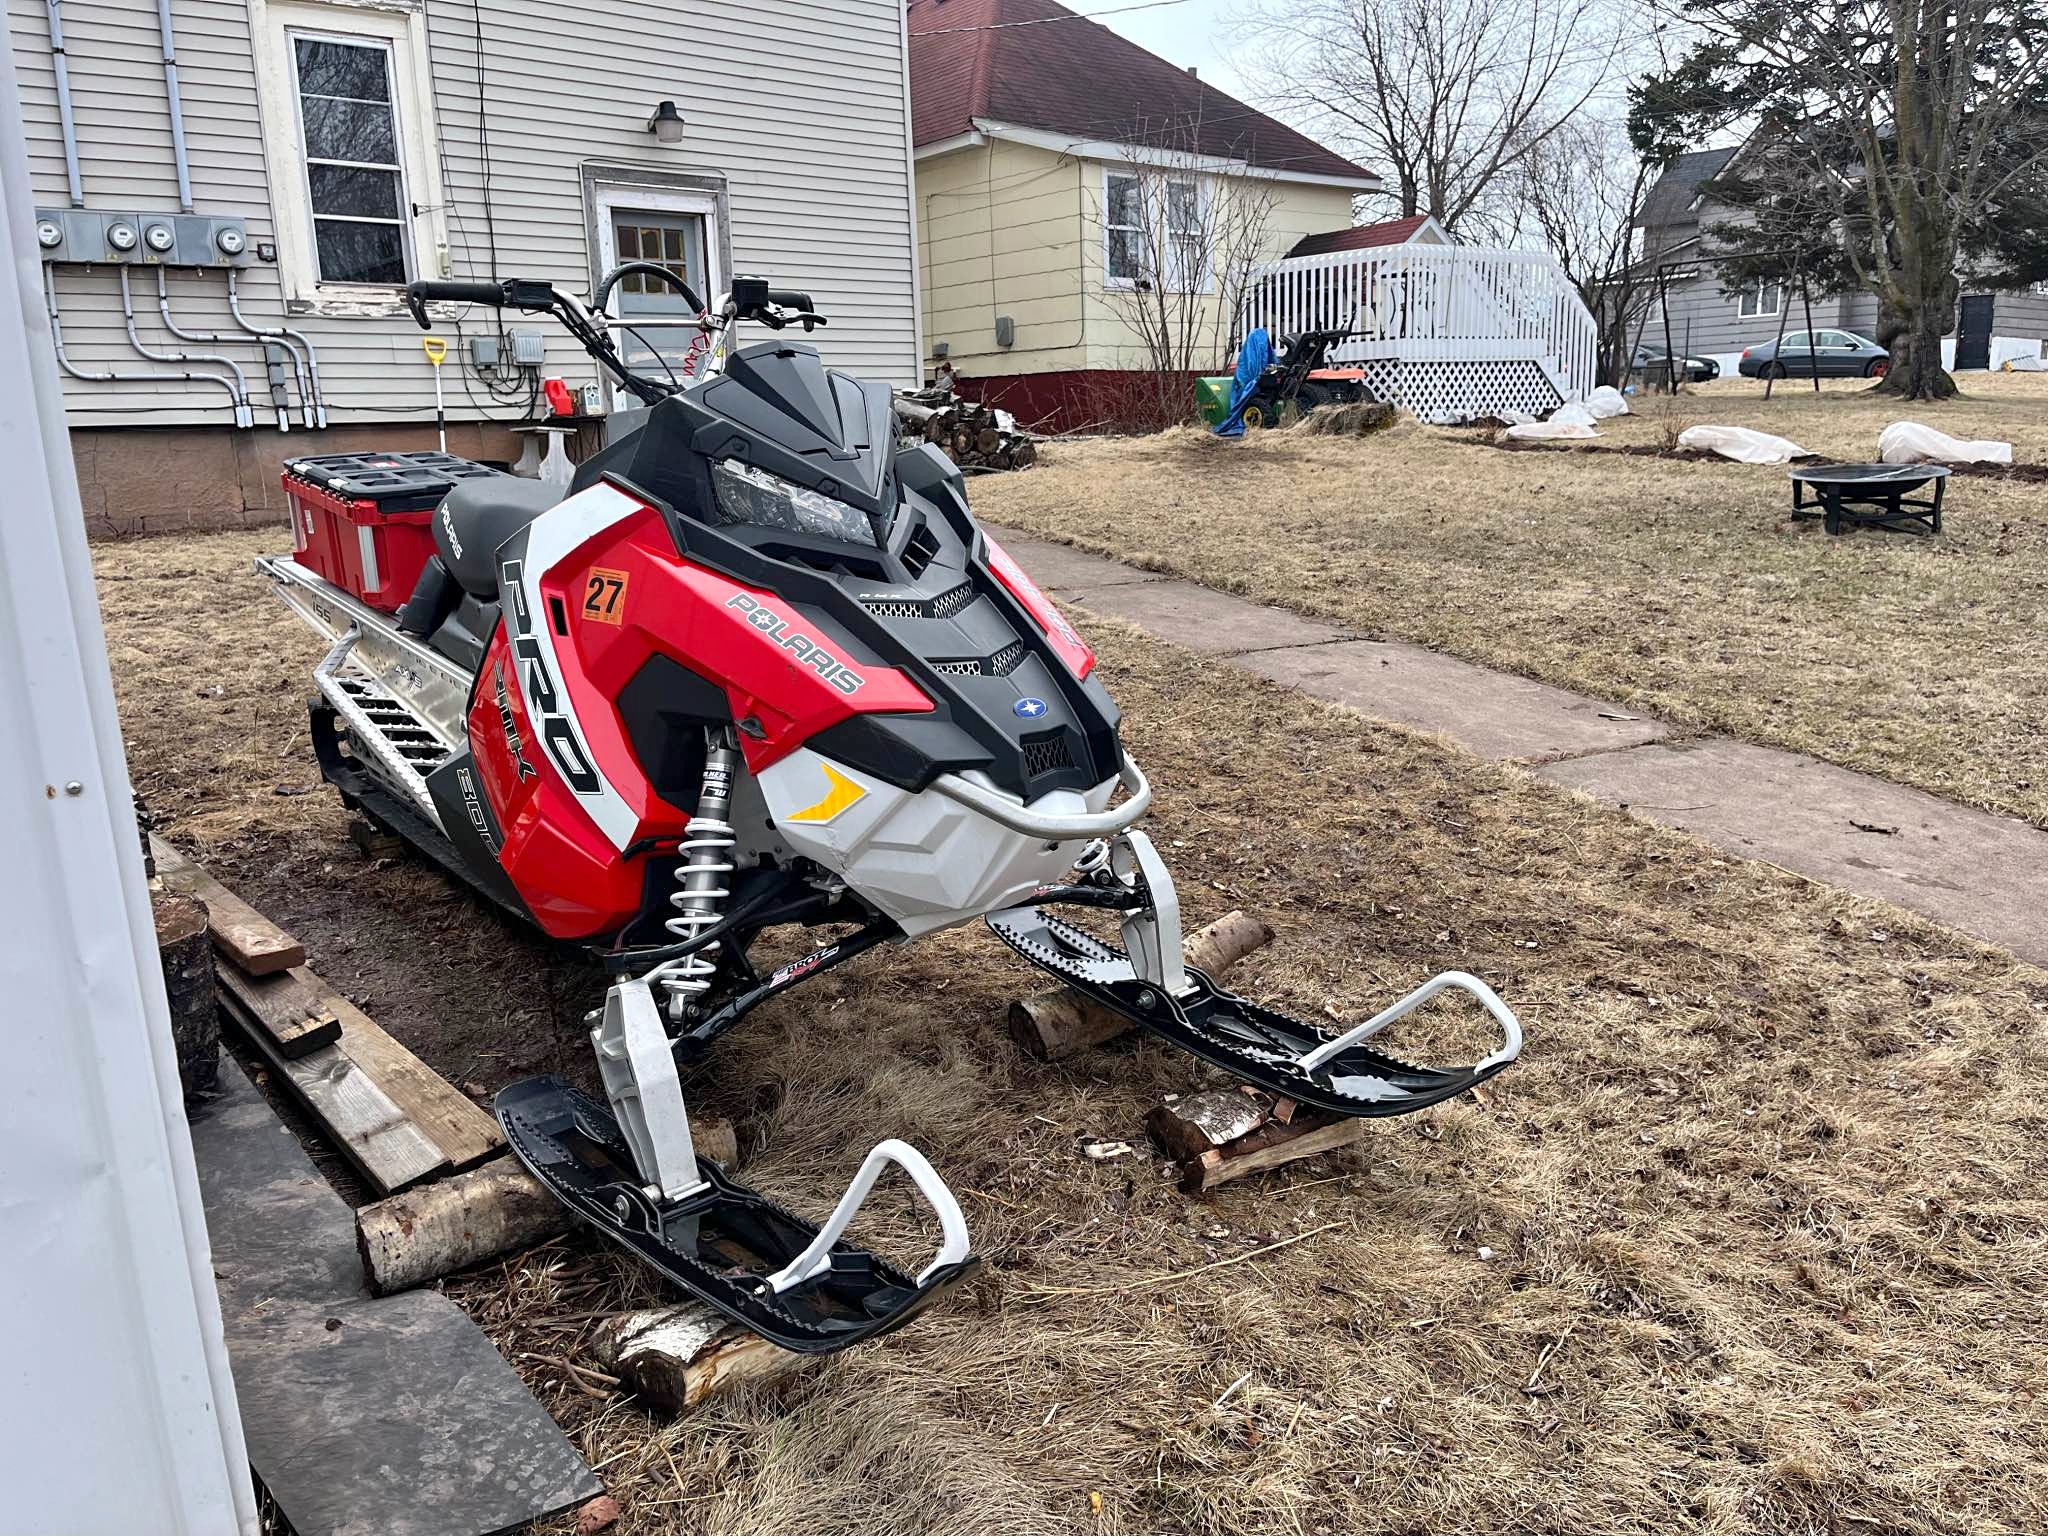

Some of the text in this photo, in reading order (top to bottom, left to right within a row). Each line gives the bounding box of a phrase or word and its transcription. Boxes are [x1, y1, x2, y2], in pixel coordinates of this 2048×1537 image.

[441, 502, 463, 560] POLARIS
[585, 576, 624, 614] 27
[502, 559, 604, 795] PRO
[725, 591, 866, 695] POLARIS
